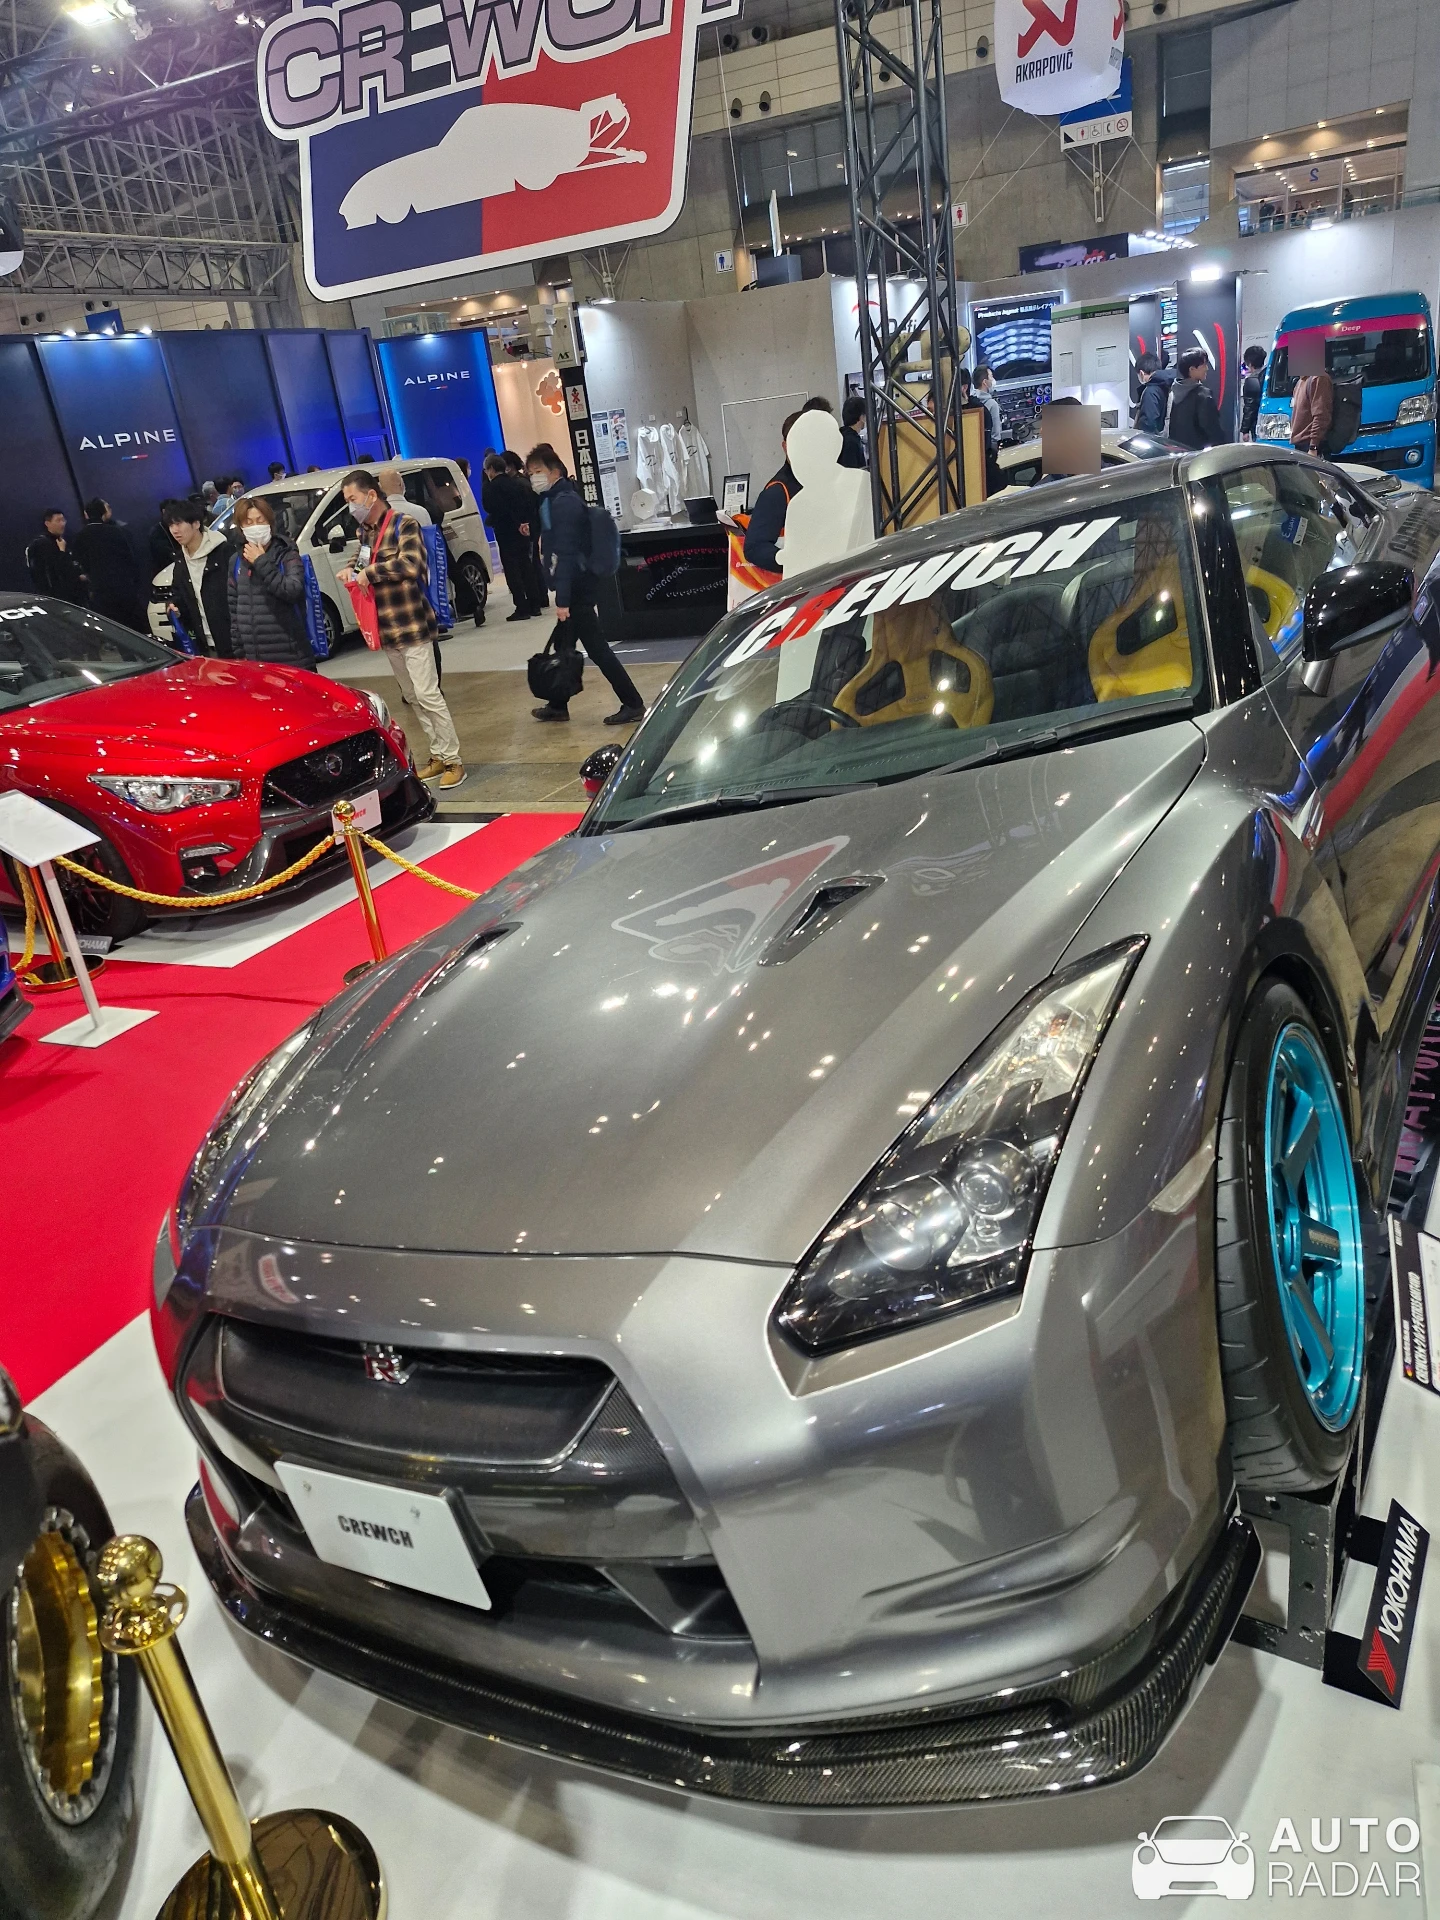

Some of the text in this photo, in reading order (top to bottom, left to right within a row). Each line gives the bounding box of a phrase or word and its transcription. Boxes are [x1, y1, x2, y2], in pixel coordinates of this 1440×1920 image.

[265, 0, 733, 130] CREWC
[404, 370, 470, 386] ALPINE
[79, 428, 176, 450] ALPINE
[723, 516, 1121, 668] CREWCH
[0, 605, 48, 623] CH
[79, 939, 108, 950] OHAMA
[337, 1514, 414, 1549] CREWCH
[1378, 1516, 1420, 1645] YOKOHAMA
